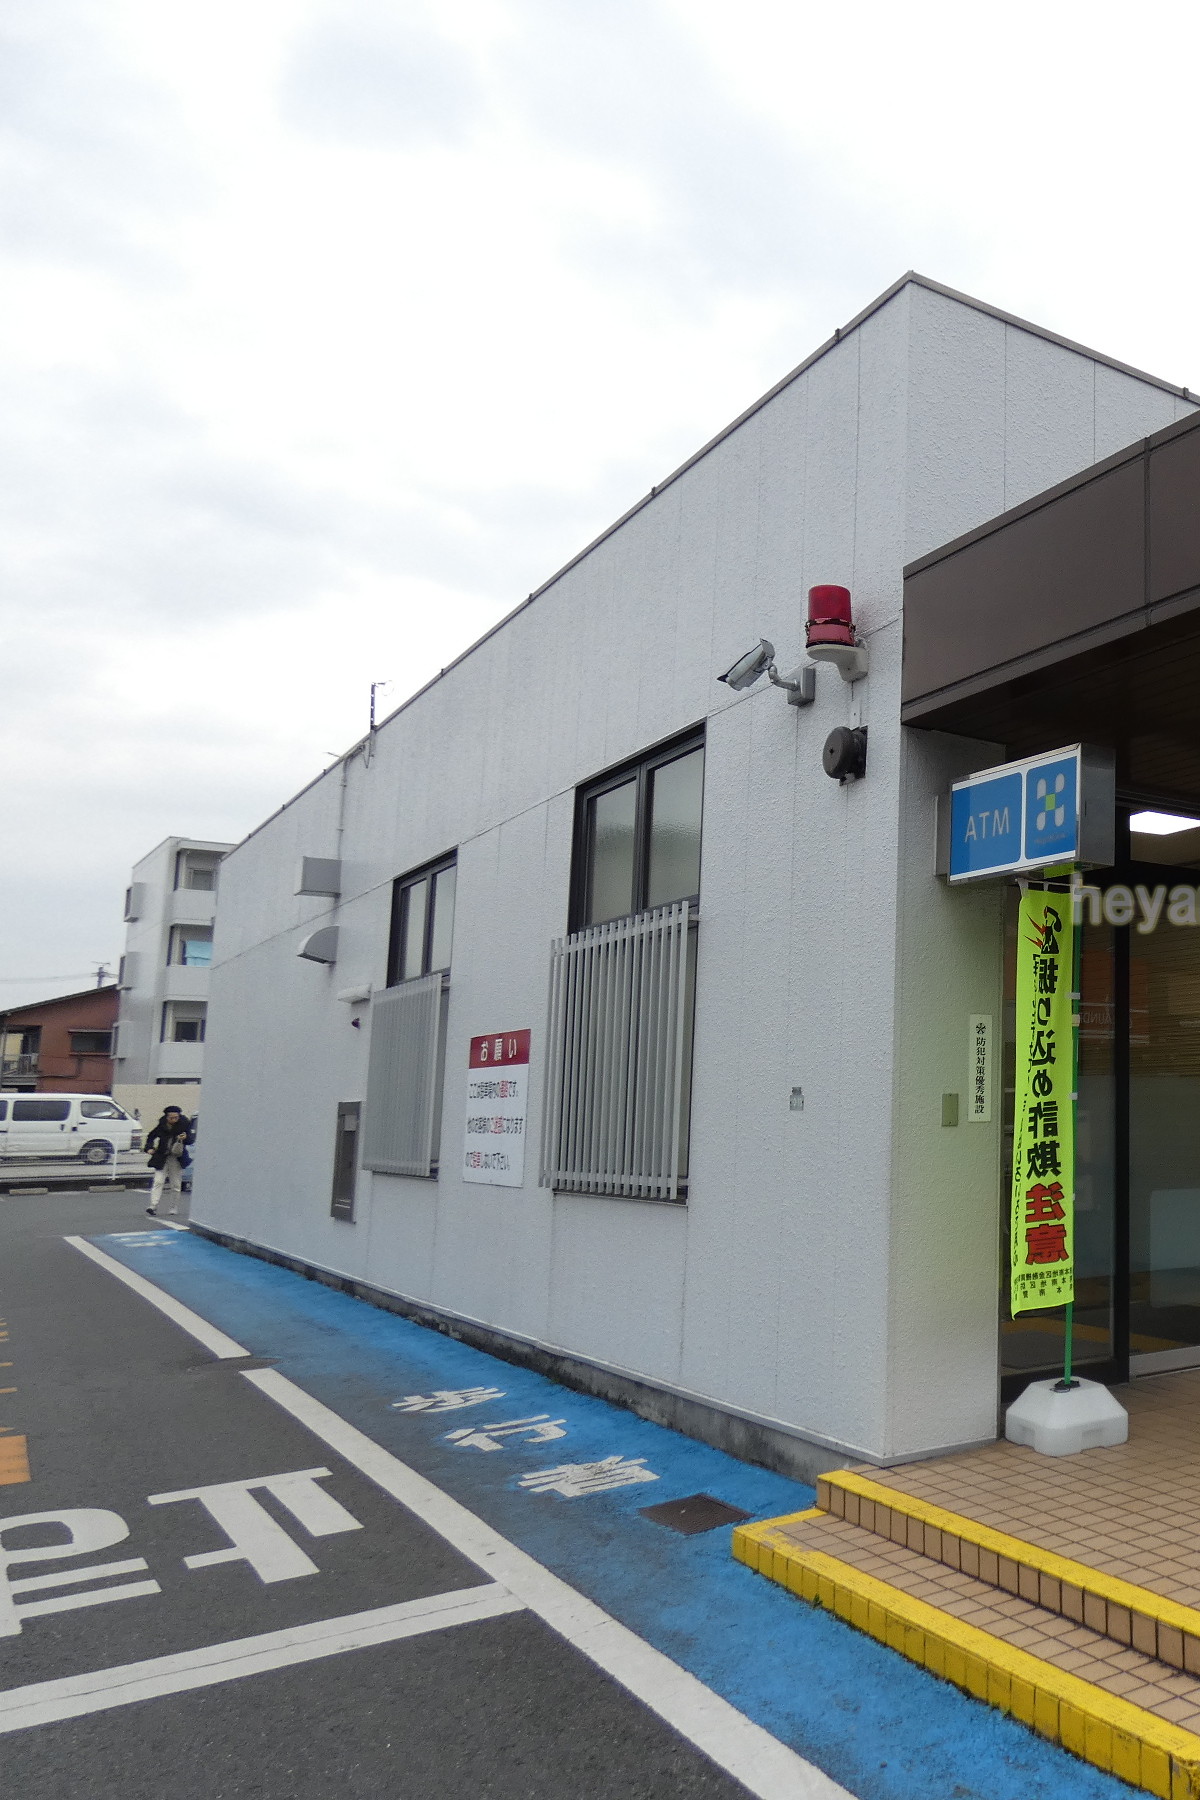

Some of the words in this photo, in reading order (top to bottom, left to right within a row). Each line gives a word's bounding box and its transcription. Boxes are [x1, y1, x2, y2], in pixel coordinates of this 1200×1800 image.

[965, 806, 1010, 843] ATM
[480, 1038, 517, 1062] お願い
[974, 1037, 987, 1114] 防犯対策優秀施設
[391, 1386, 661, 1498] 歩行者
